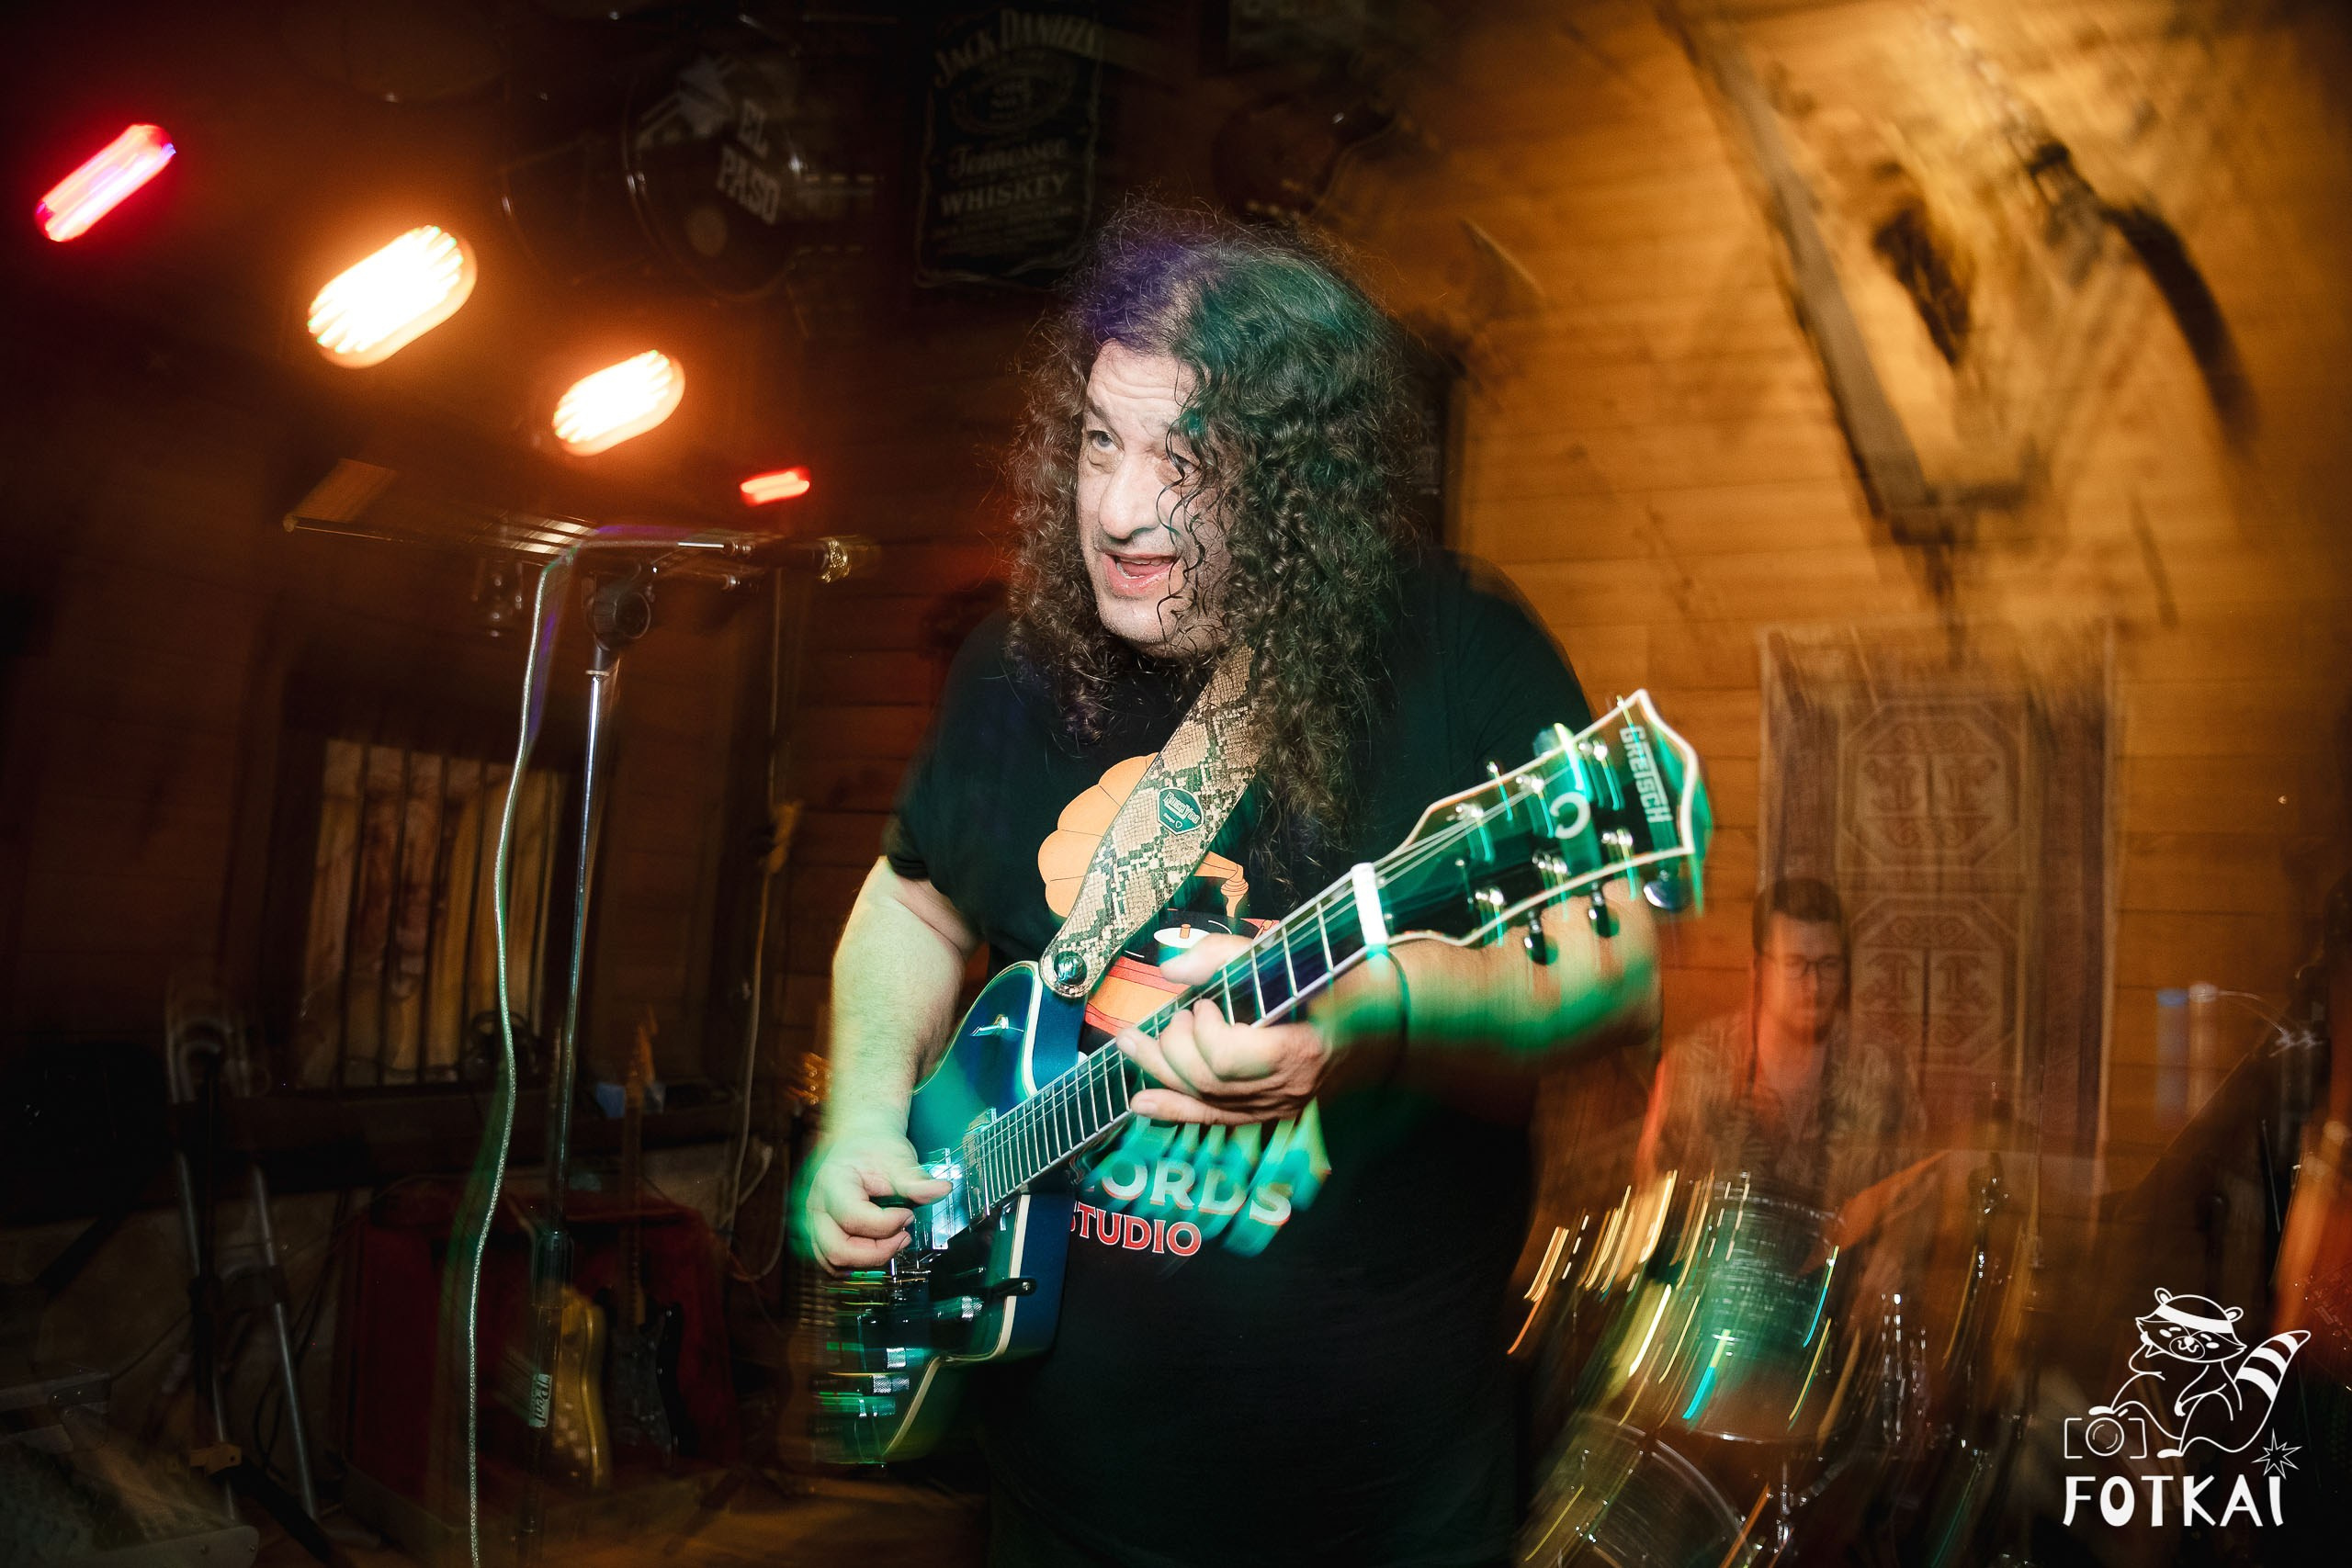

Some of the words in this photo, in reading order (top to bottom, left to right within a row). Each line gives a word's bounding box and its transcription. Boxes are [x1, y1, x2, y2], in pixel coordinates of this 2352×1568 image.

[737, 98, 770, 161] EL
[716, 142, 781, 227] PASO
[939, 170, 1072, 218] WHISKEY
